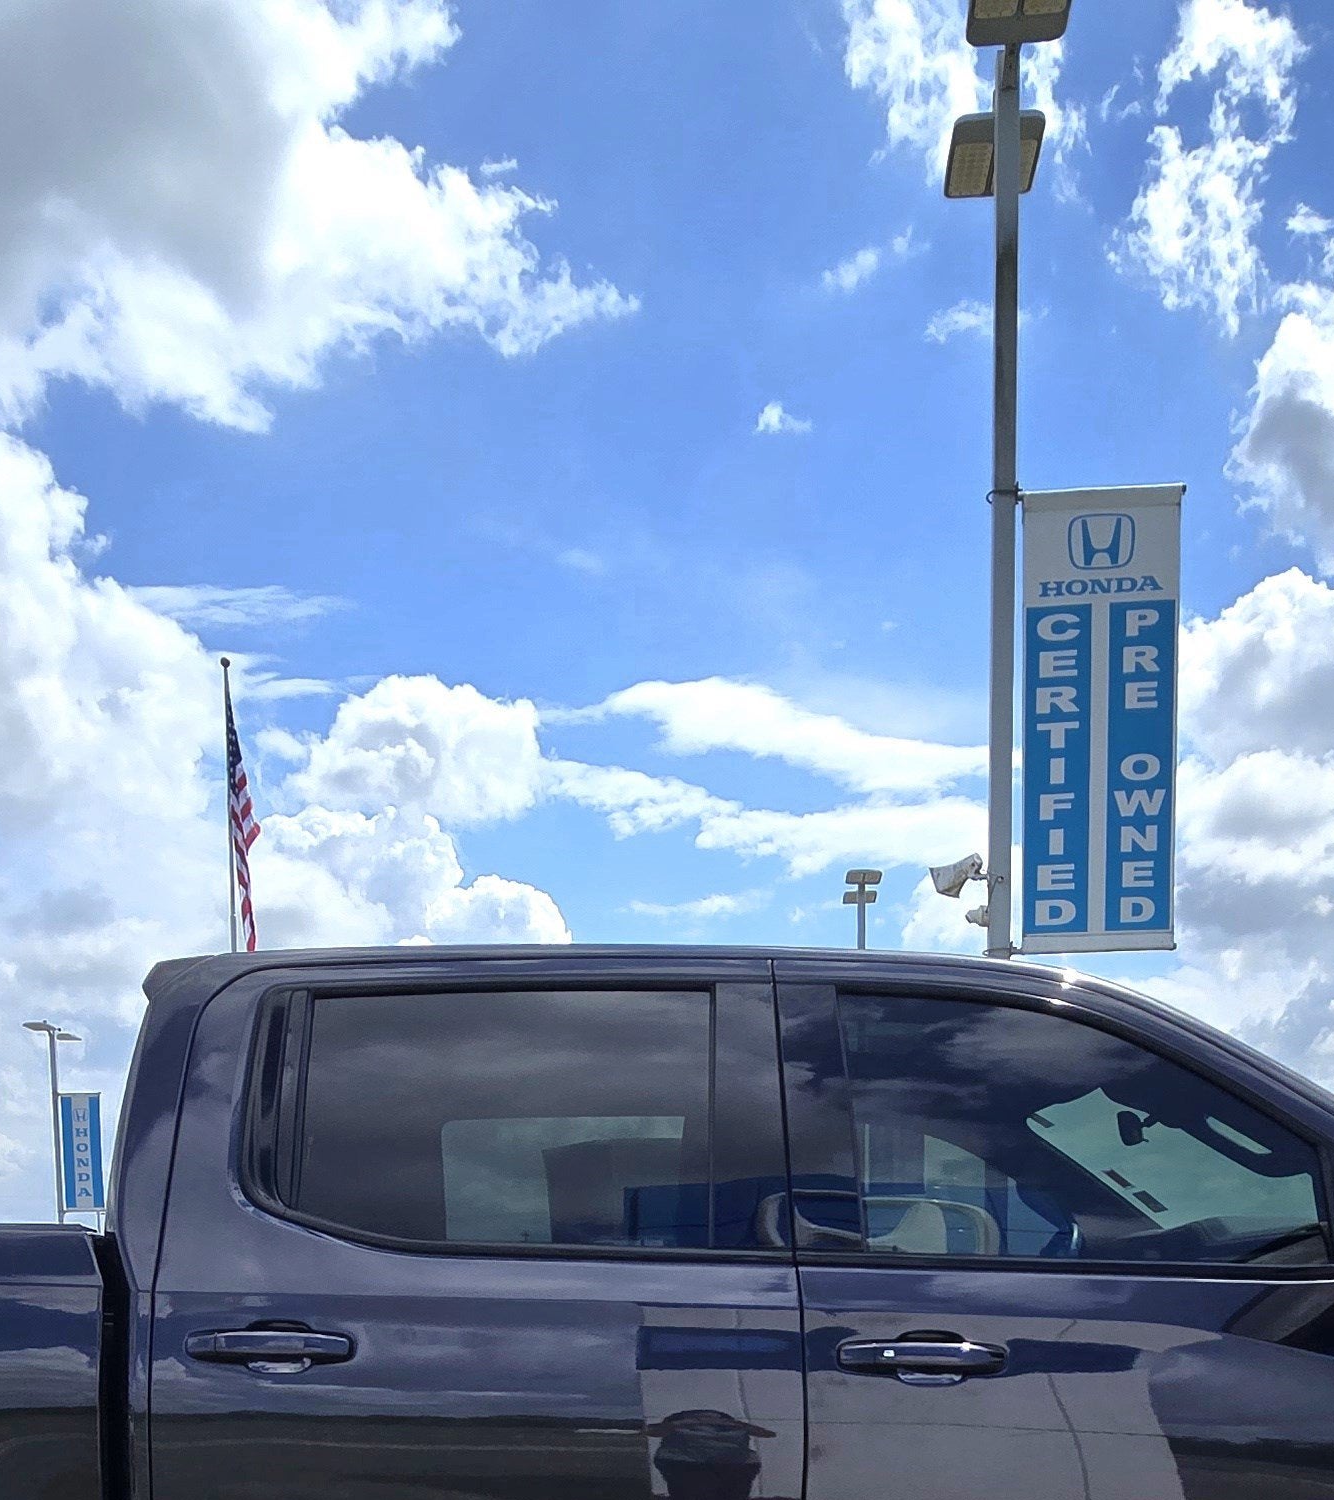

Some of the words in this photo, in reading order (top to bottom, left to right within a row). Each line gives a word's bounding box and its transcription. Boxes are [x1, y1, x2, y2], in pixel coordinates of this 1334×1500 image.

[1039, 575, 1164, 598] HONDA
[1123, 608, 1160, 709] PRE
[1035, 613, 1081, 926] CERTIFIED
[1113, 753, 1167, 923] OWNED
[75, 1127, 92, 1197] HONDA
